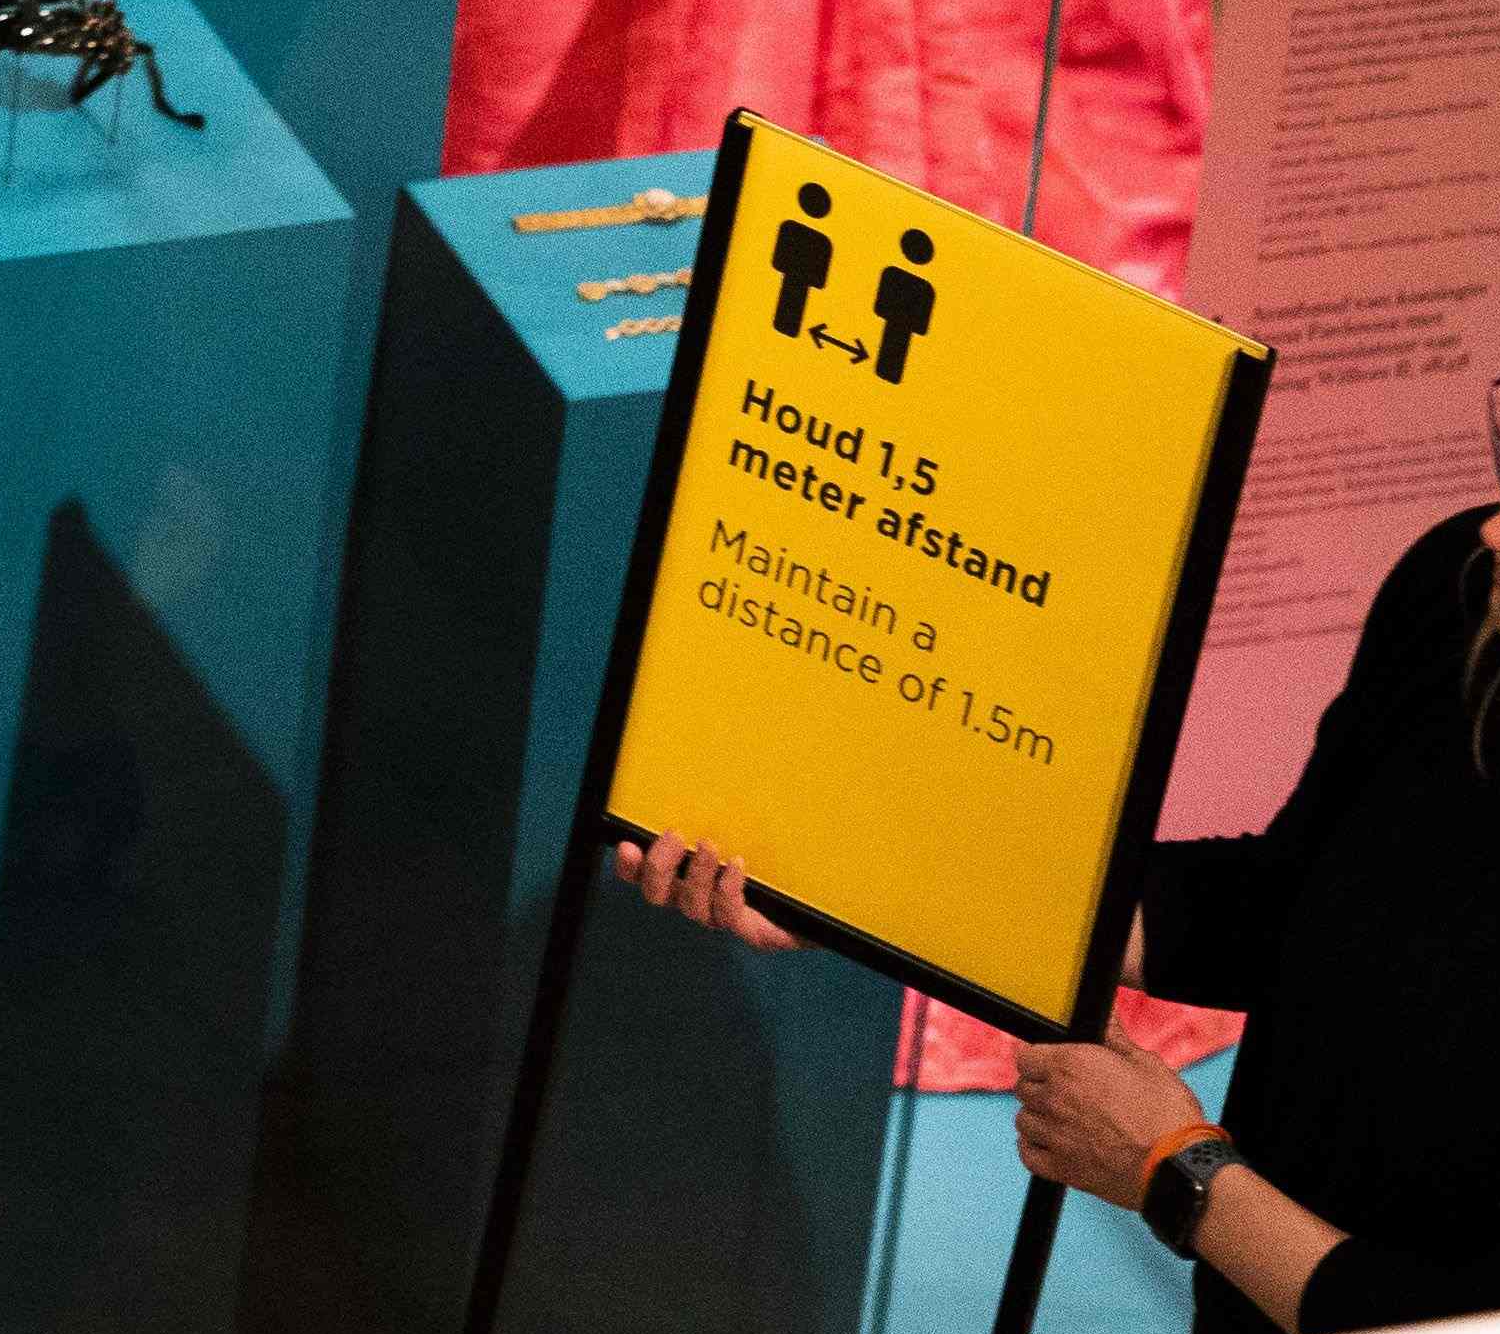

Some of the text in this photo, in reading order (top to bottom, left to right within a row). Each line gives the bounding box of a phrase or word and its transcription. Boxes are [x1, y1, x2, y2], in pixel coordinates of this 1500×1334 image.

[740, 379, 940, 496] Houd 1,5
[709, 518, 938, 653] Maintain a
[728, 436, 1052, 609] meter afstand
[697, 575, 1055, 765] distance of 1.5m
